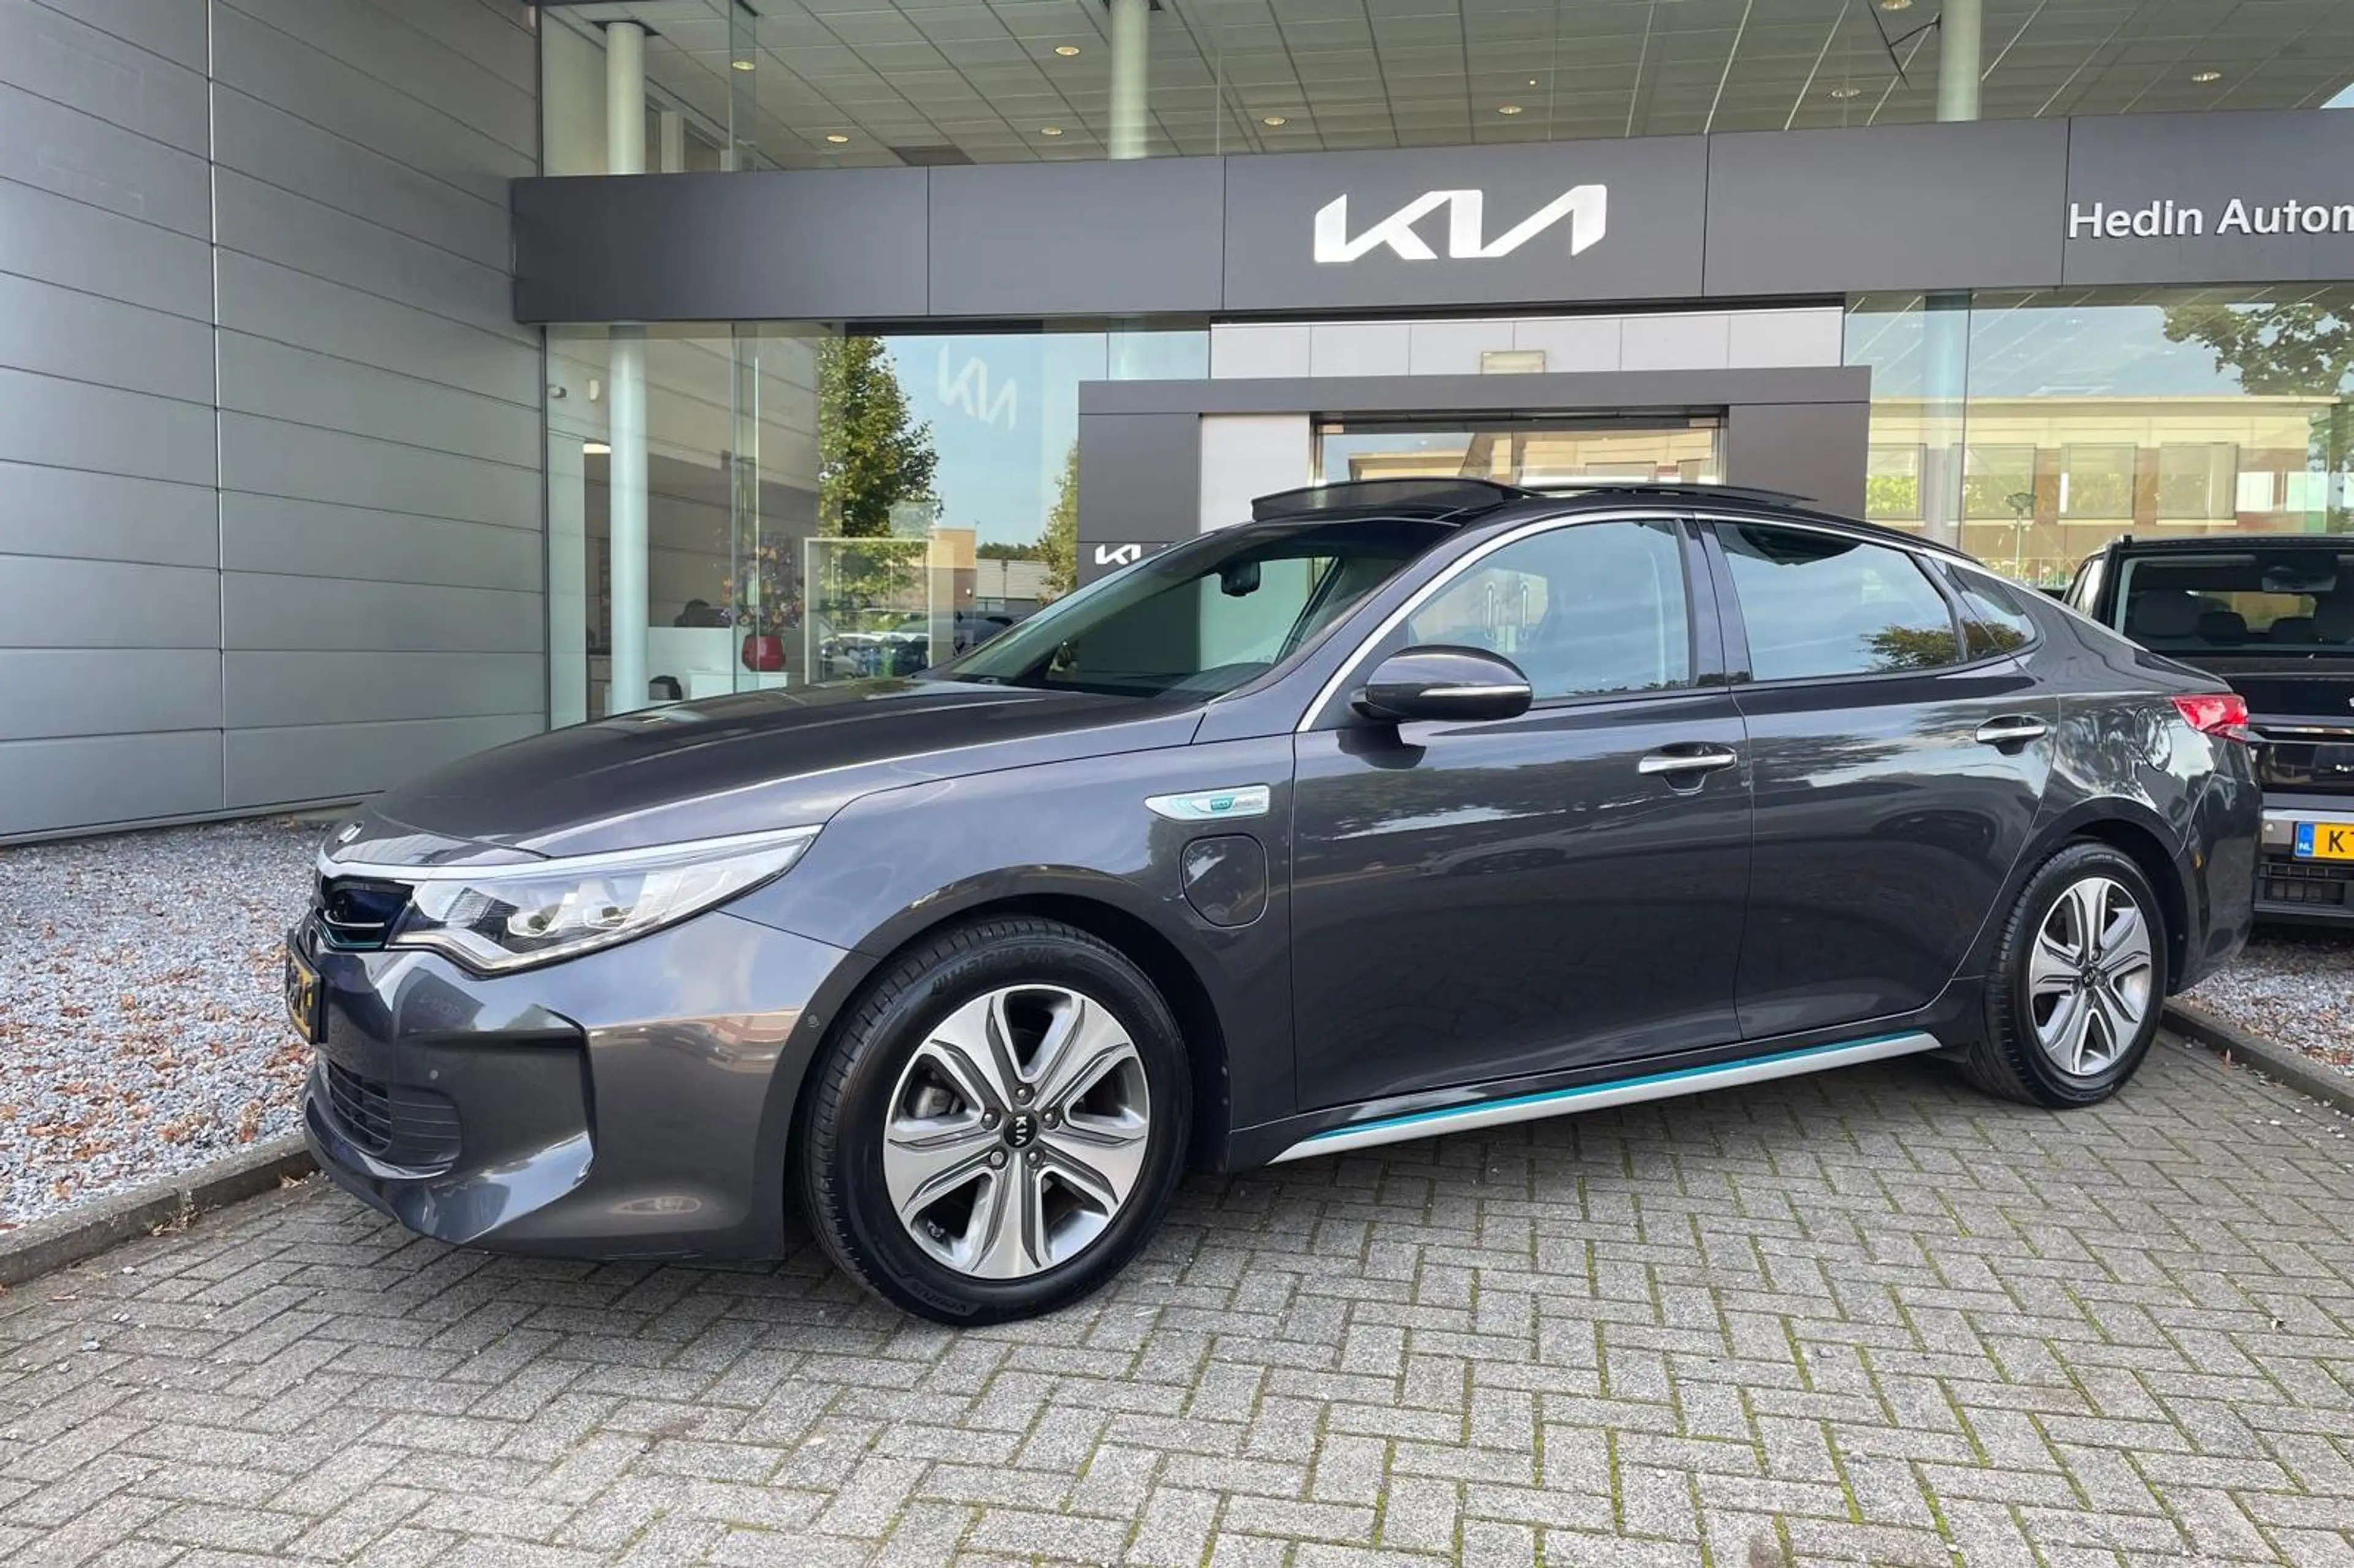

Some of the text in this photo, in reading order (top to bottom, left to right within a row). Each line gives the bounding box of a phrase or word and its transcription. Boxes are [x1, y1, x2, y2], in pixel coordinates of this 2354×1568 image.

[1314, 184, 1607, 263] KIA
[2068, 200, 2203, 238] Hedin
[1095, 544, 1141, 565] KI
[2299, 842, 2312, 851] NL
[1015, 1116, 1028, 1146] KIA
